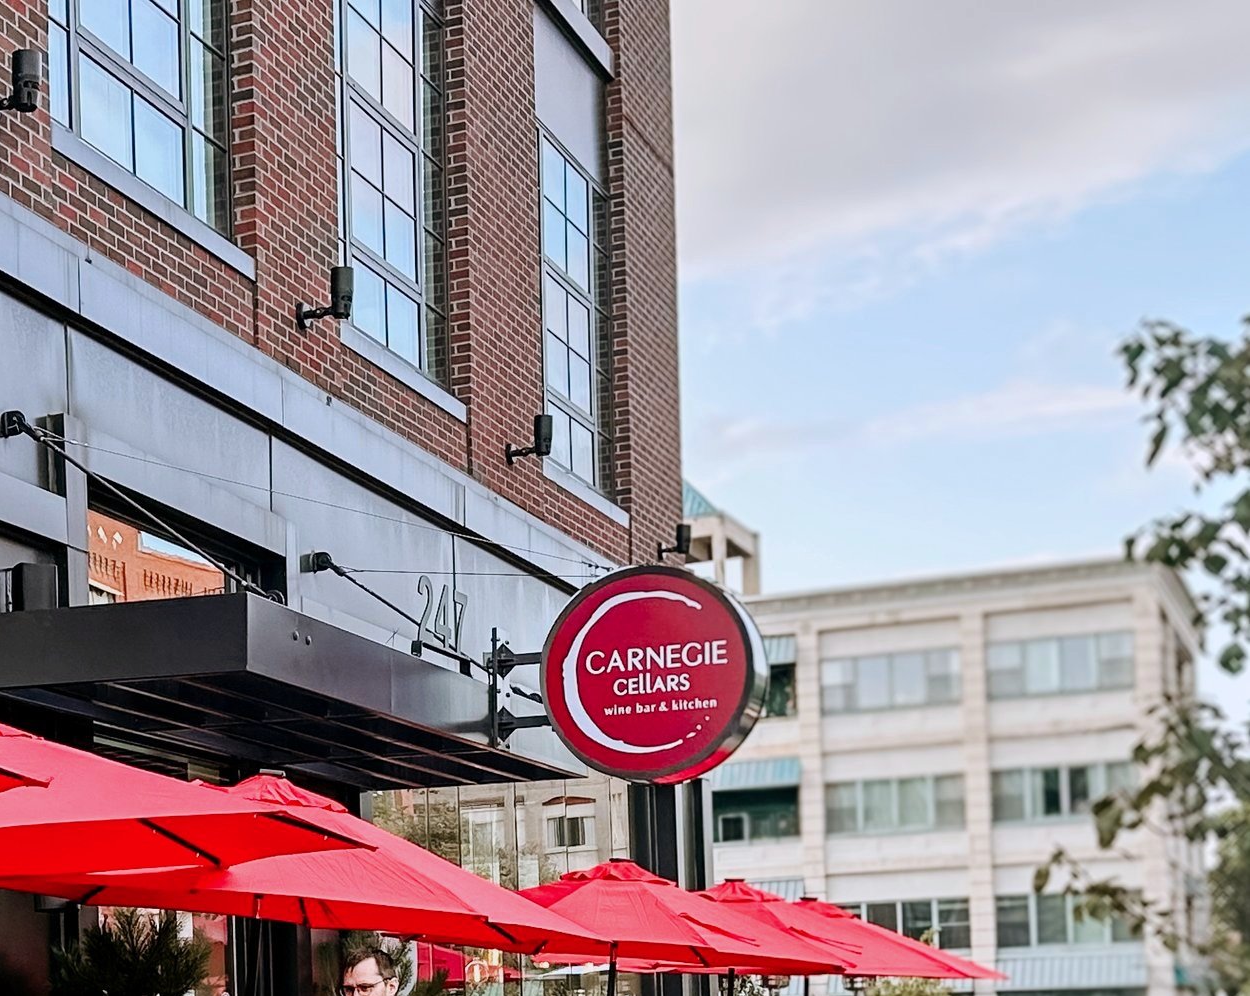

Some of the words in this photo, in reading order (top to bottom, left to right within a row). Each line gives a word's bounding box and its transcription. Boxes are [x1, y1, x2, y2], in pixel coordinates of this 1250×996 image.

[417, 574, 468, 656] 247
[585, 639, 729, 675] CARNEGIE
[603, 704, 632, 716] wine
[635, 702, 657, 714] bar
[658, 701, 669, 712] &
[671, 697, 718, 711] kitchen
